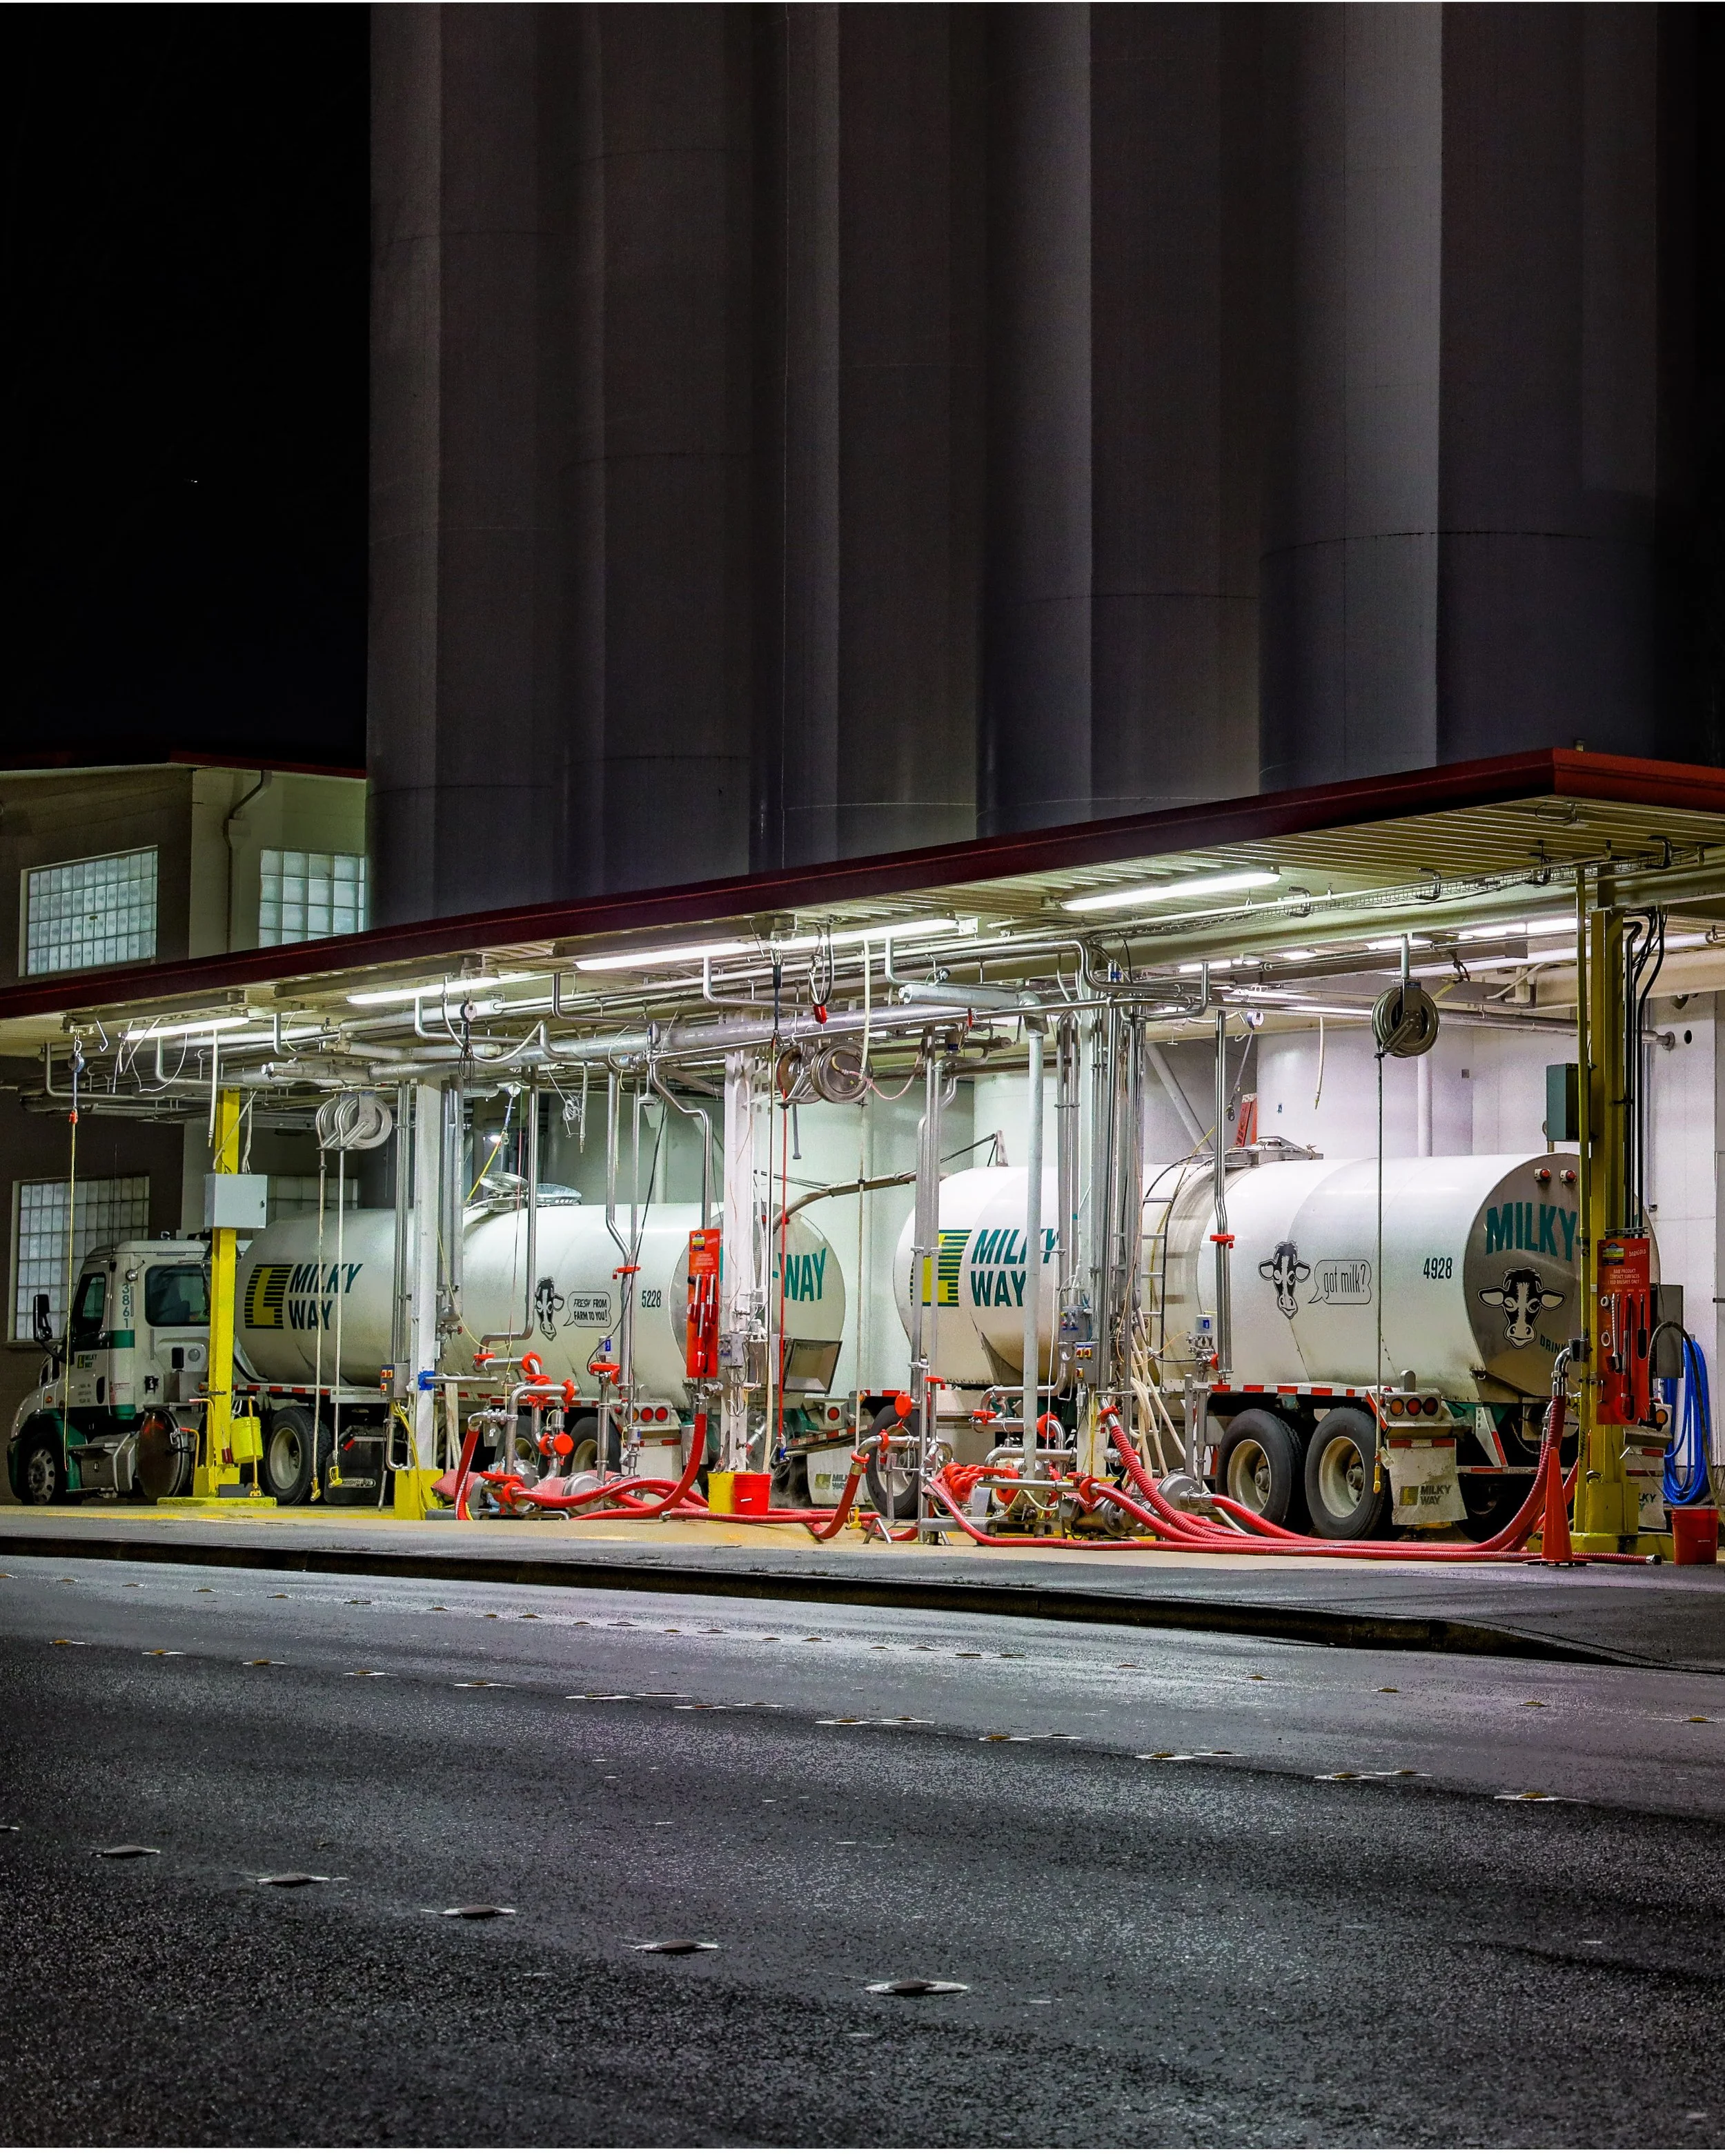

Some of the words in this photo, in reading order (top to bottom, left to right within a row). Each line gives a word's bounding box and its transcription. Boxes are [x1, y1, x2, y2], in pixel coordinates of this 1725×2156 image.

[1423, 1257, 1452, 1279] 4928
[289, 1263, 364, 1294] MILKY
[1323, 1266, 1337, 1300] got
[1341, 1264, 1366, 1293] milk?
[642, 1290, 662, 1308] 5228
[971, 1271, 1026, 1307] WAY
[573, 1298, 591, 1307] FRESH
[593, 1299, 607, 1308] FROM
[288, 1300, 333, 1329] WAY
[574, 1311, 588, 1321] FARM
[589, 1312, 595, 1321] TO
[595, 1310, 607, 1322] YOU!
[1420, 1495, 1441, 1505] WAY
[1421, 1485, 1452, 1495] MILKY
